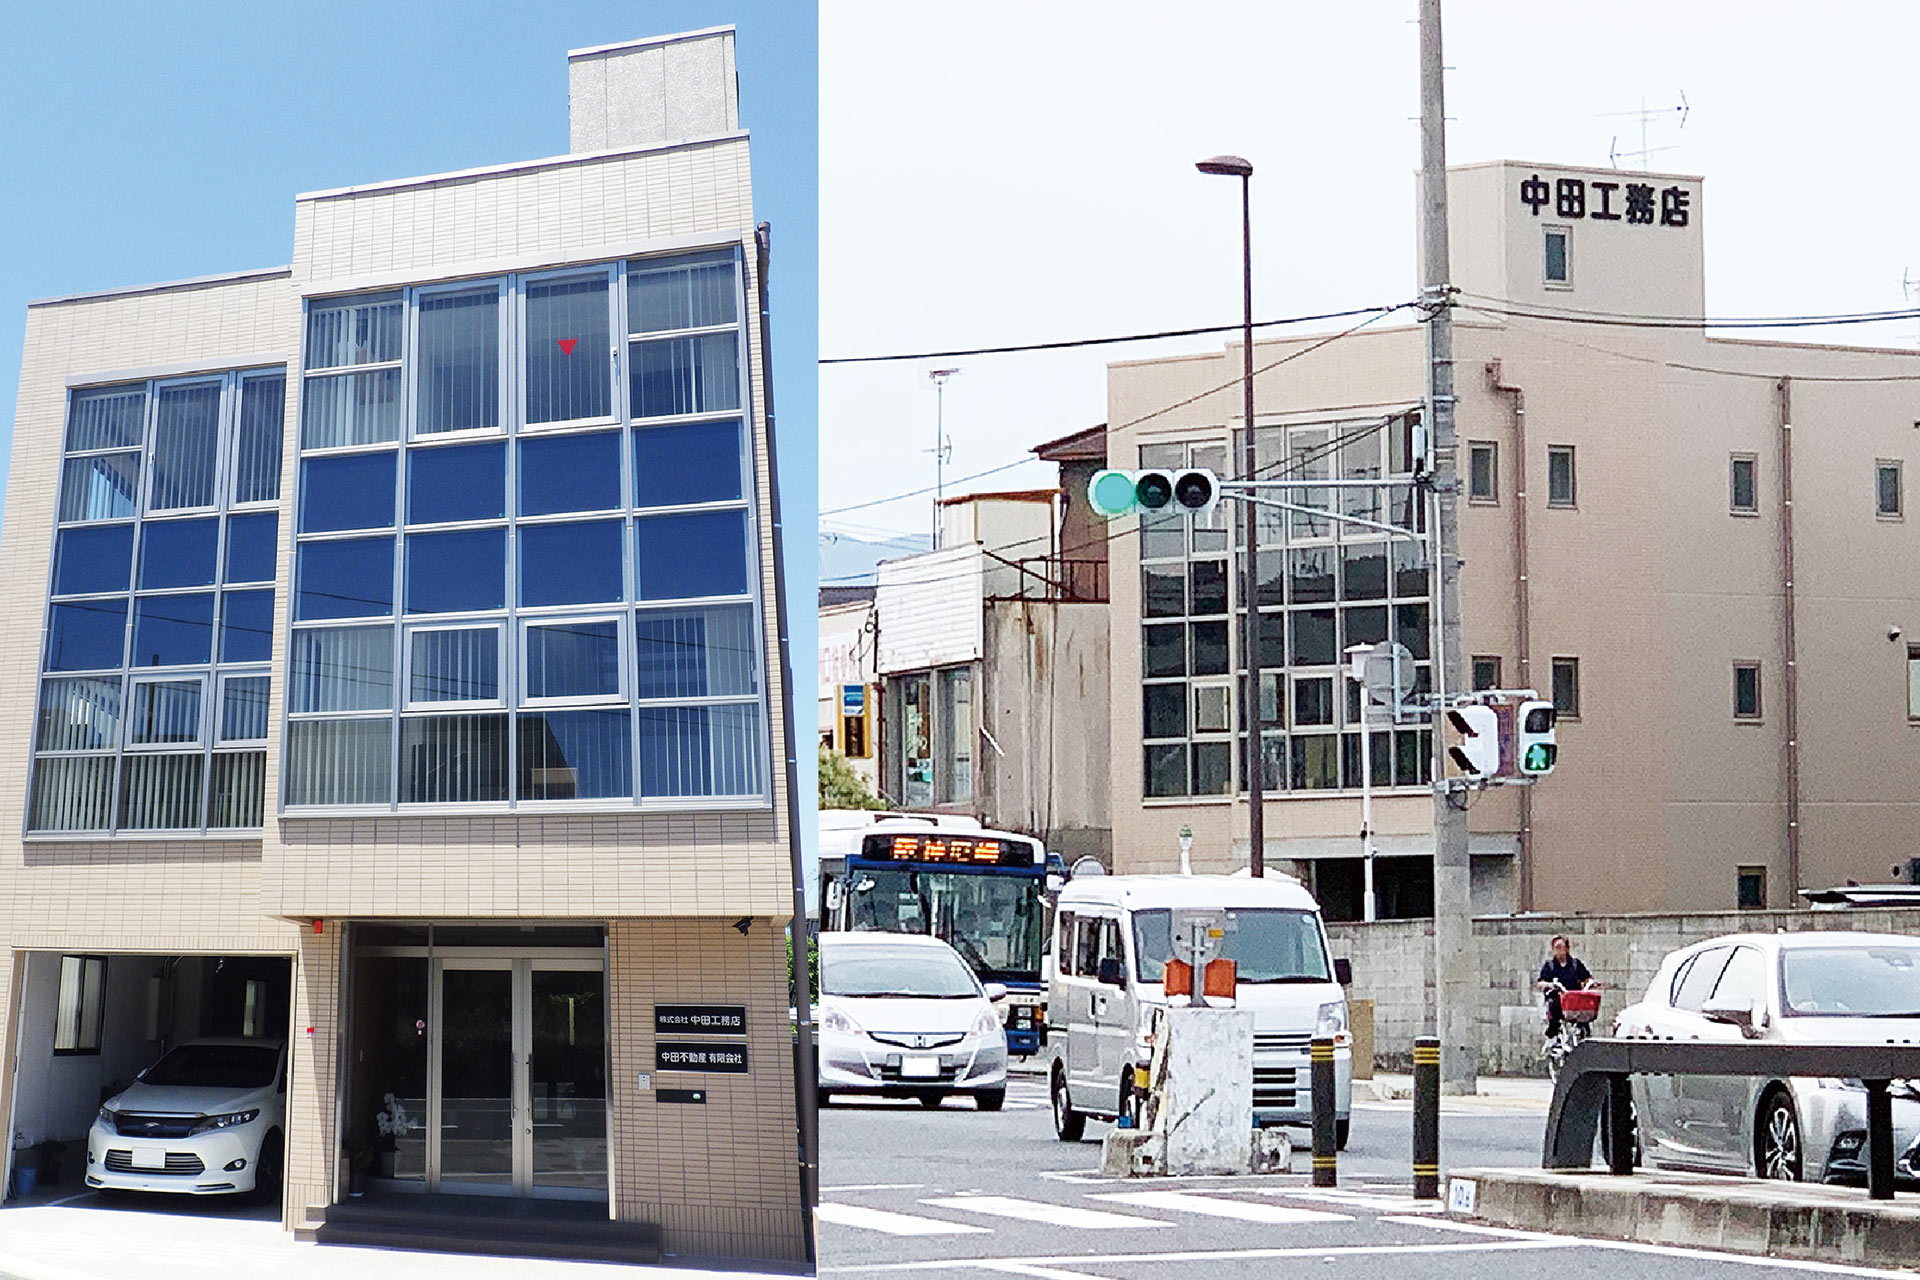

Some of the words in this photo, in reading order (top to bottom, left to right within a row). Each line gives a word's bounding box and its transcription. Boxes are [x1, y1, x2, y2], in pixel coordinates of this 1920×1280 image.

[1520, 174, 1690, 227] 中田工務店
[659, 1015, 689, 1024] 株式会社
[690, 1015, 741, 1026] 中田工務店
[661, 1051, 707, 1063] 中田不動産
[708, 1052, 743, 1064] 有限会社
